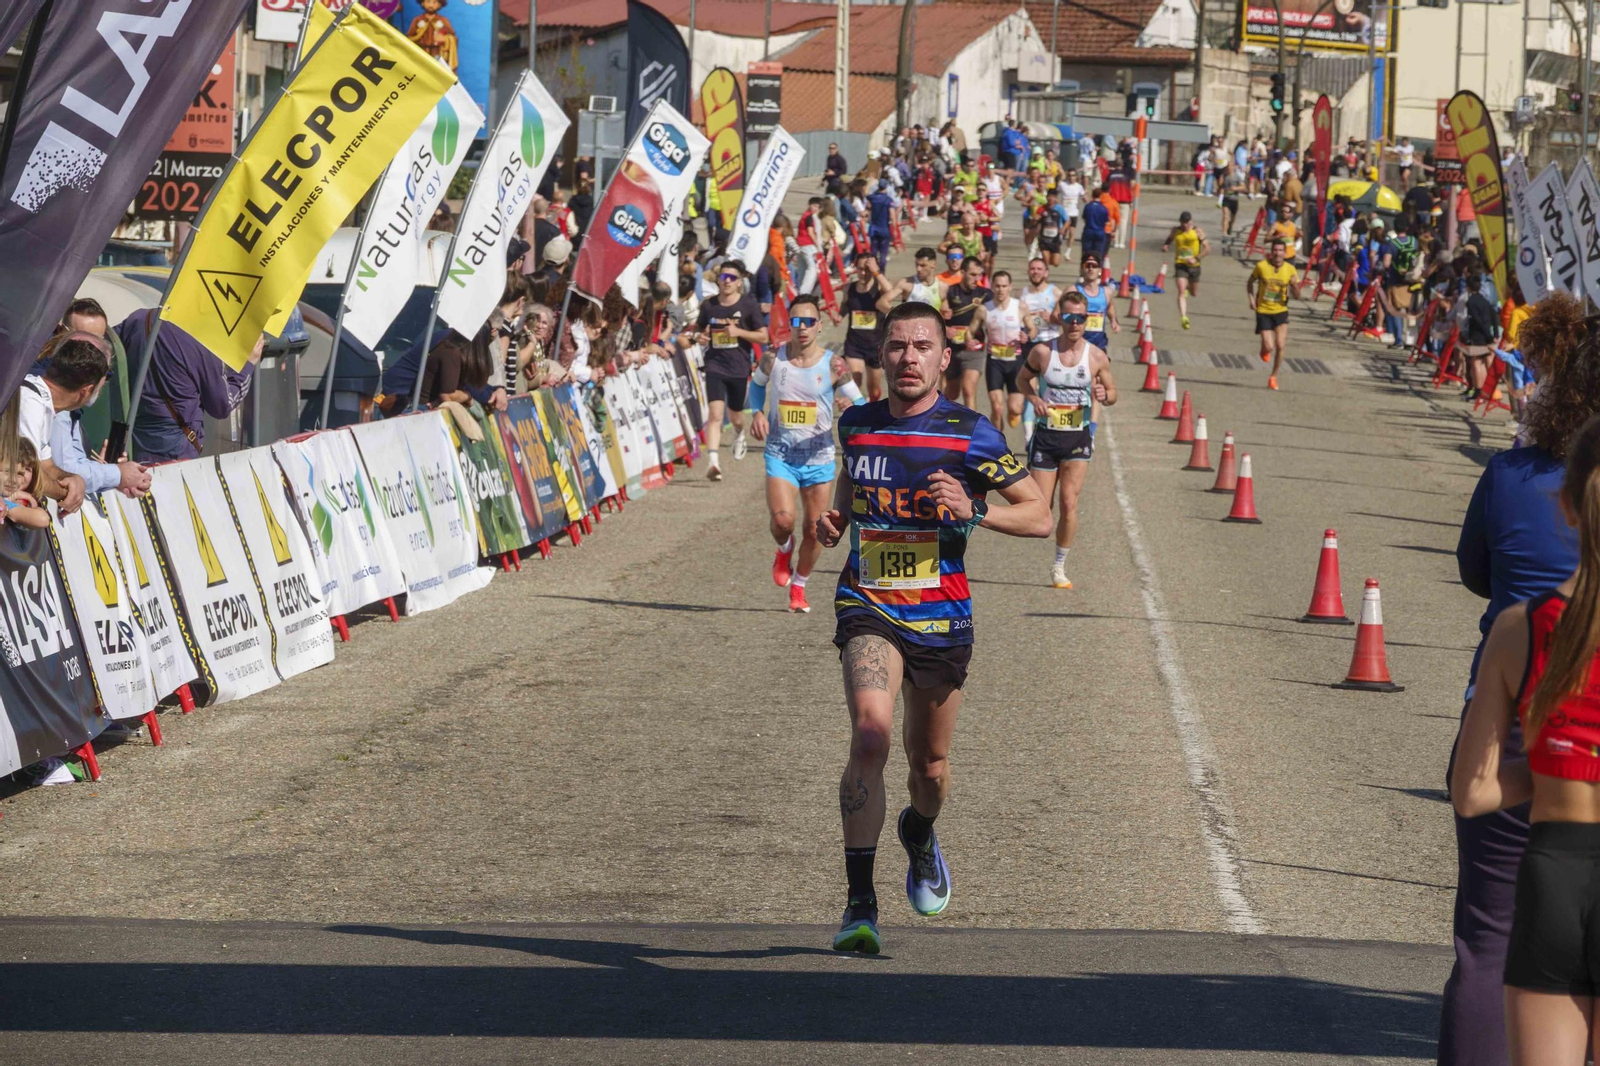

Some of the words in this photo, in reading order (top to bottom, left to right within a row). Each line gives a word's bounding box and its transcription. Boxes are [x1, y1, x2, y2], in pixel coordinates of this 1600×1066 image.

[227, 46, 397, 254] ELECPOR
[650, 123, 686, 164] Giga
[259, 184, 324, 268] INSTALACIONES
[320, 177, 331, 185] Y
[328, 91, 399, 177] MANTENIMIENTO
[142, 182, 213, 213] 202
[613, 209, 647, 238] Giga
[787, 410, 806, 424] 109
[1060, 414, 1073, 426] 68
[880, 551, 916, 578] 138
